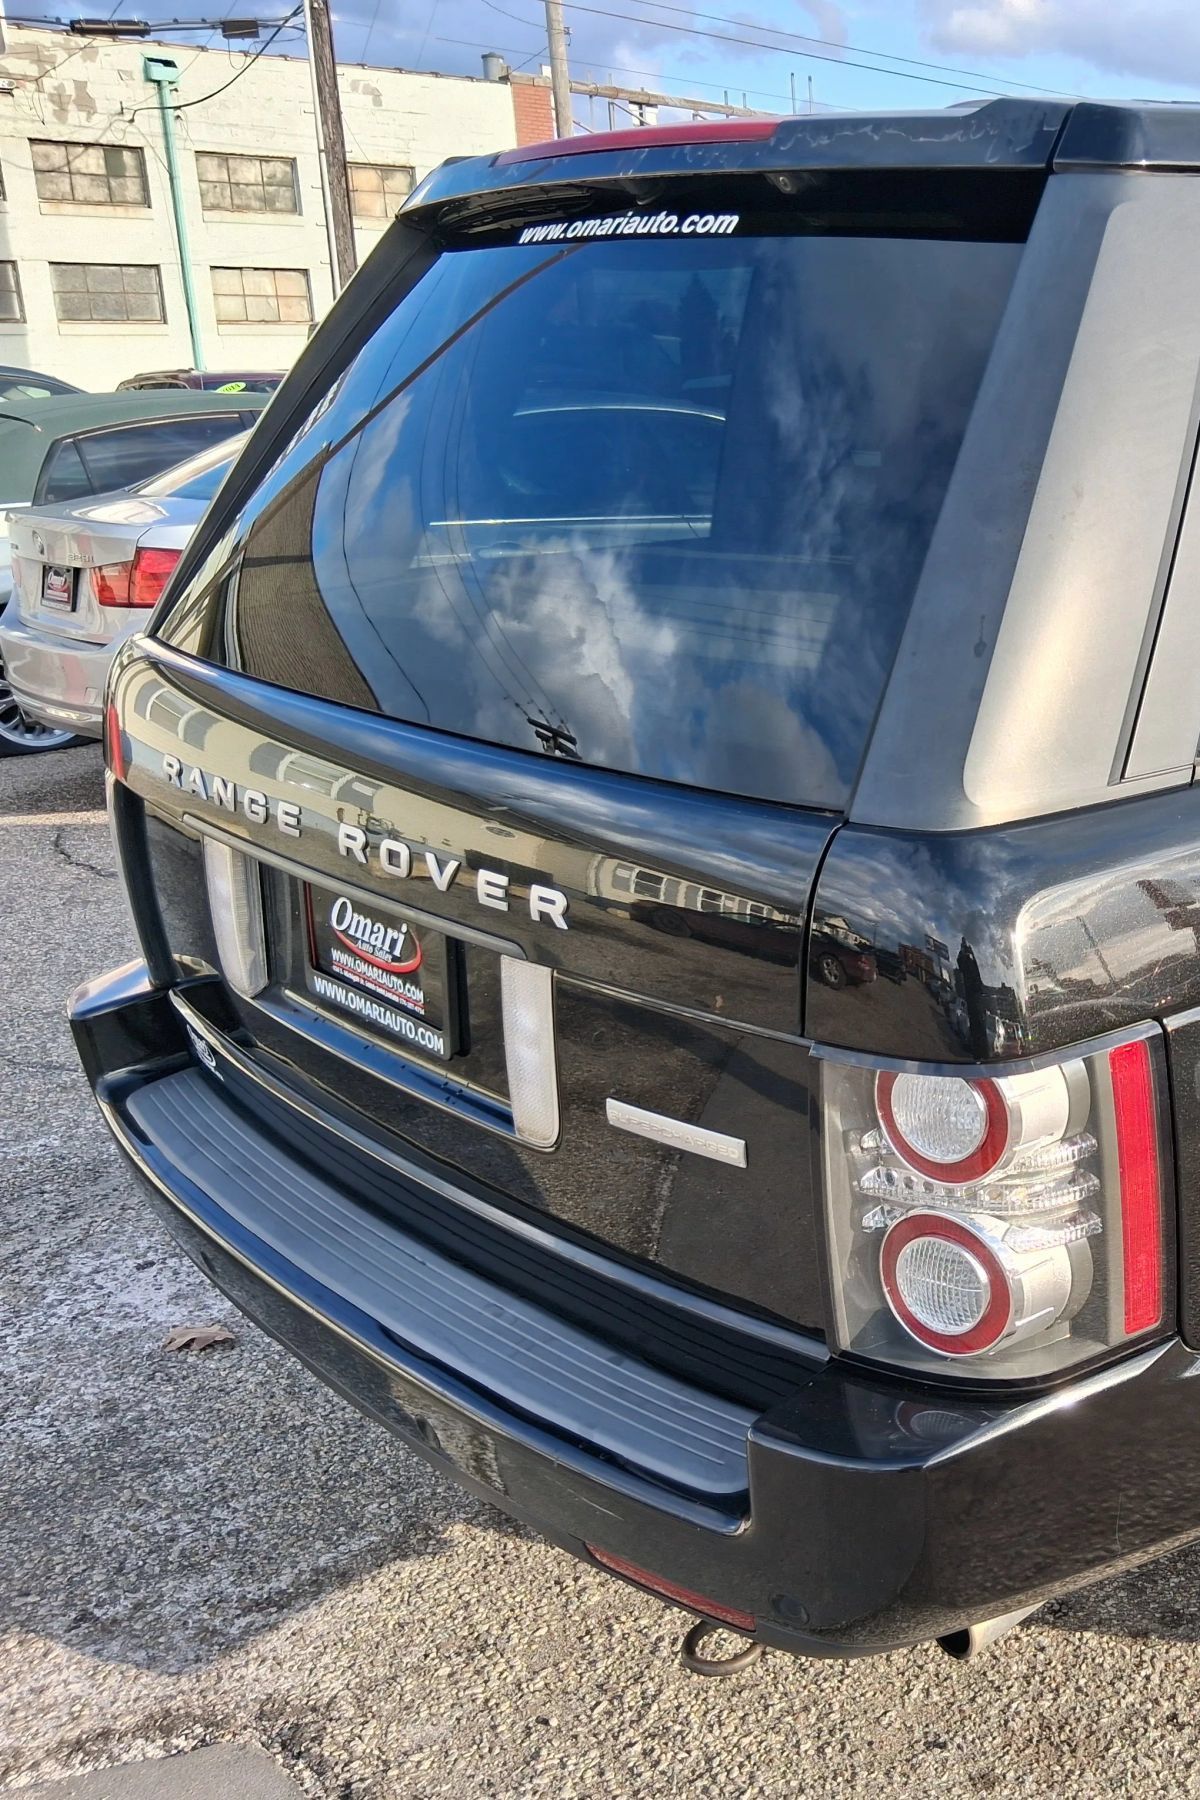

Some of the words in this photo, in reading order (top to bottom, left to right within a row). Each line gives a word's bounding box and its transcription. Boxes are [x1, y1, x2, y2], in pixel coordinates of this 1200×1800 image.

[518, 210, 740, 245] www.omariauto.com
[162, 753, 302, 838] RANGE
[337, 822, 569, 931] ROVER
[330, 896, 408, 958] Omari
[355, 939, 374, 955] Auto
[374, 949, 393, 963] Sales
[330, 947, 425, 1005] WWW.OMARIAUTO.COM
[313, 975, 445, 1056] WWW.OMARIAUTO.COM
[609, 1110, 740, 1160] SUPERCHARGED
